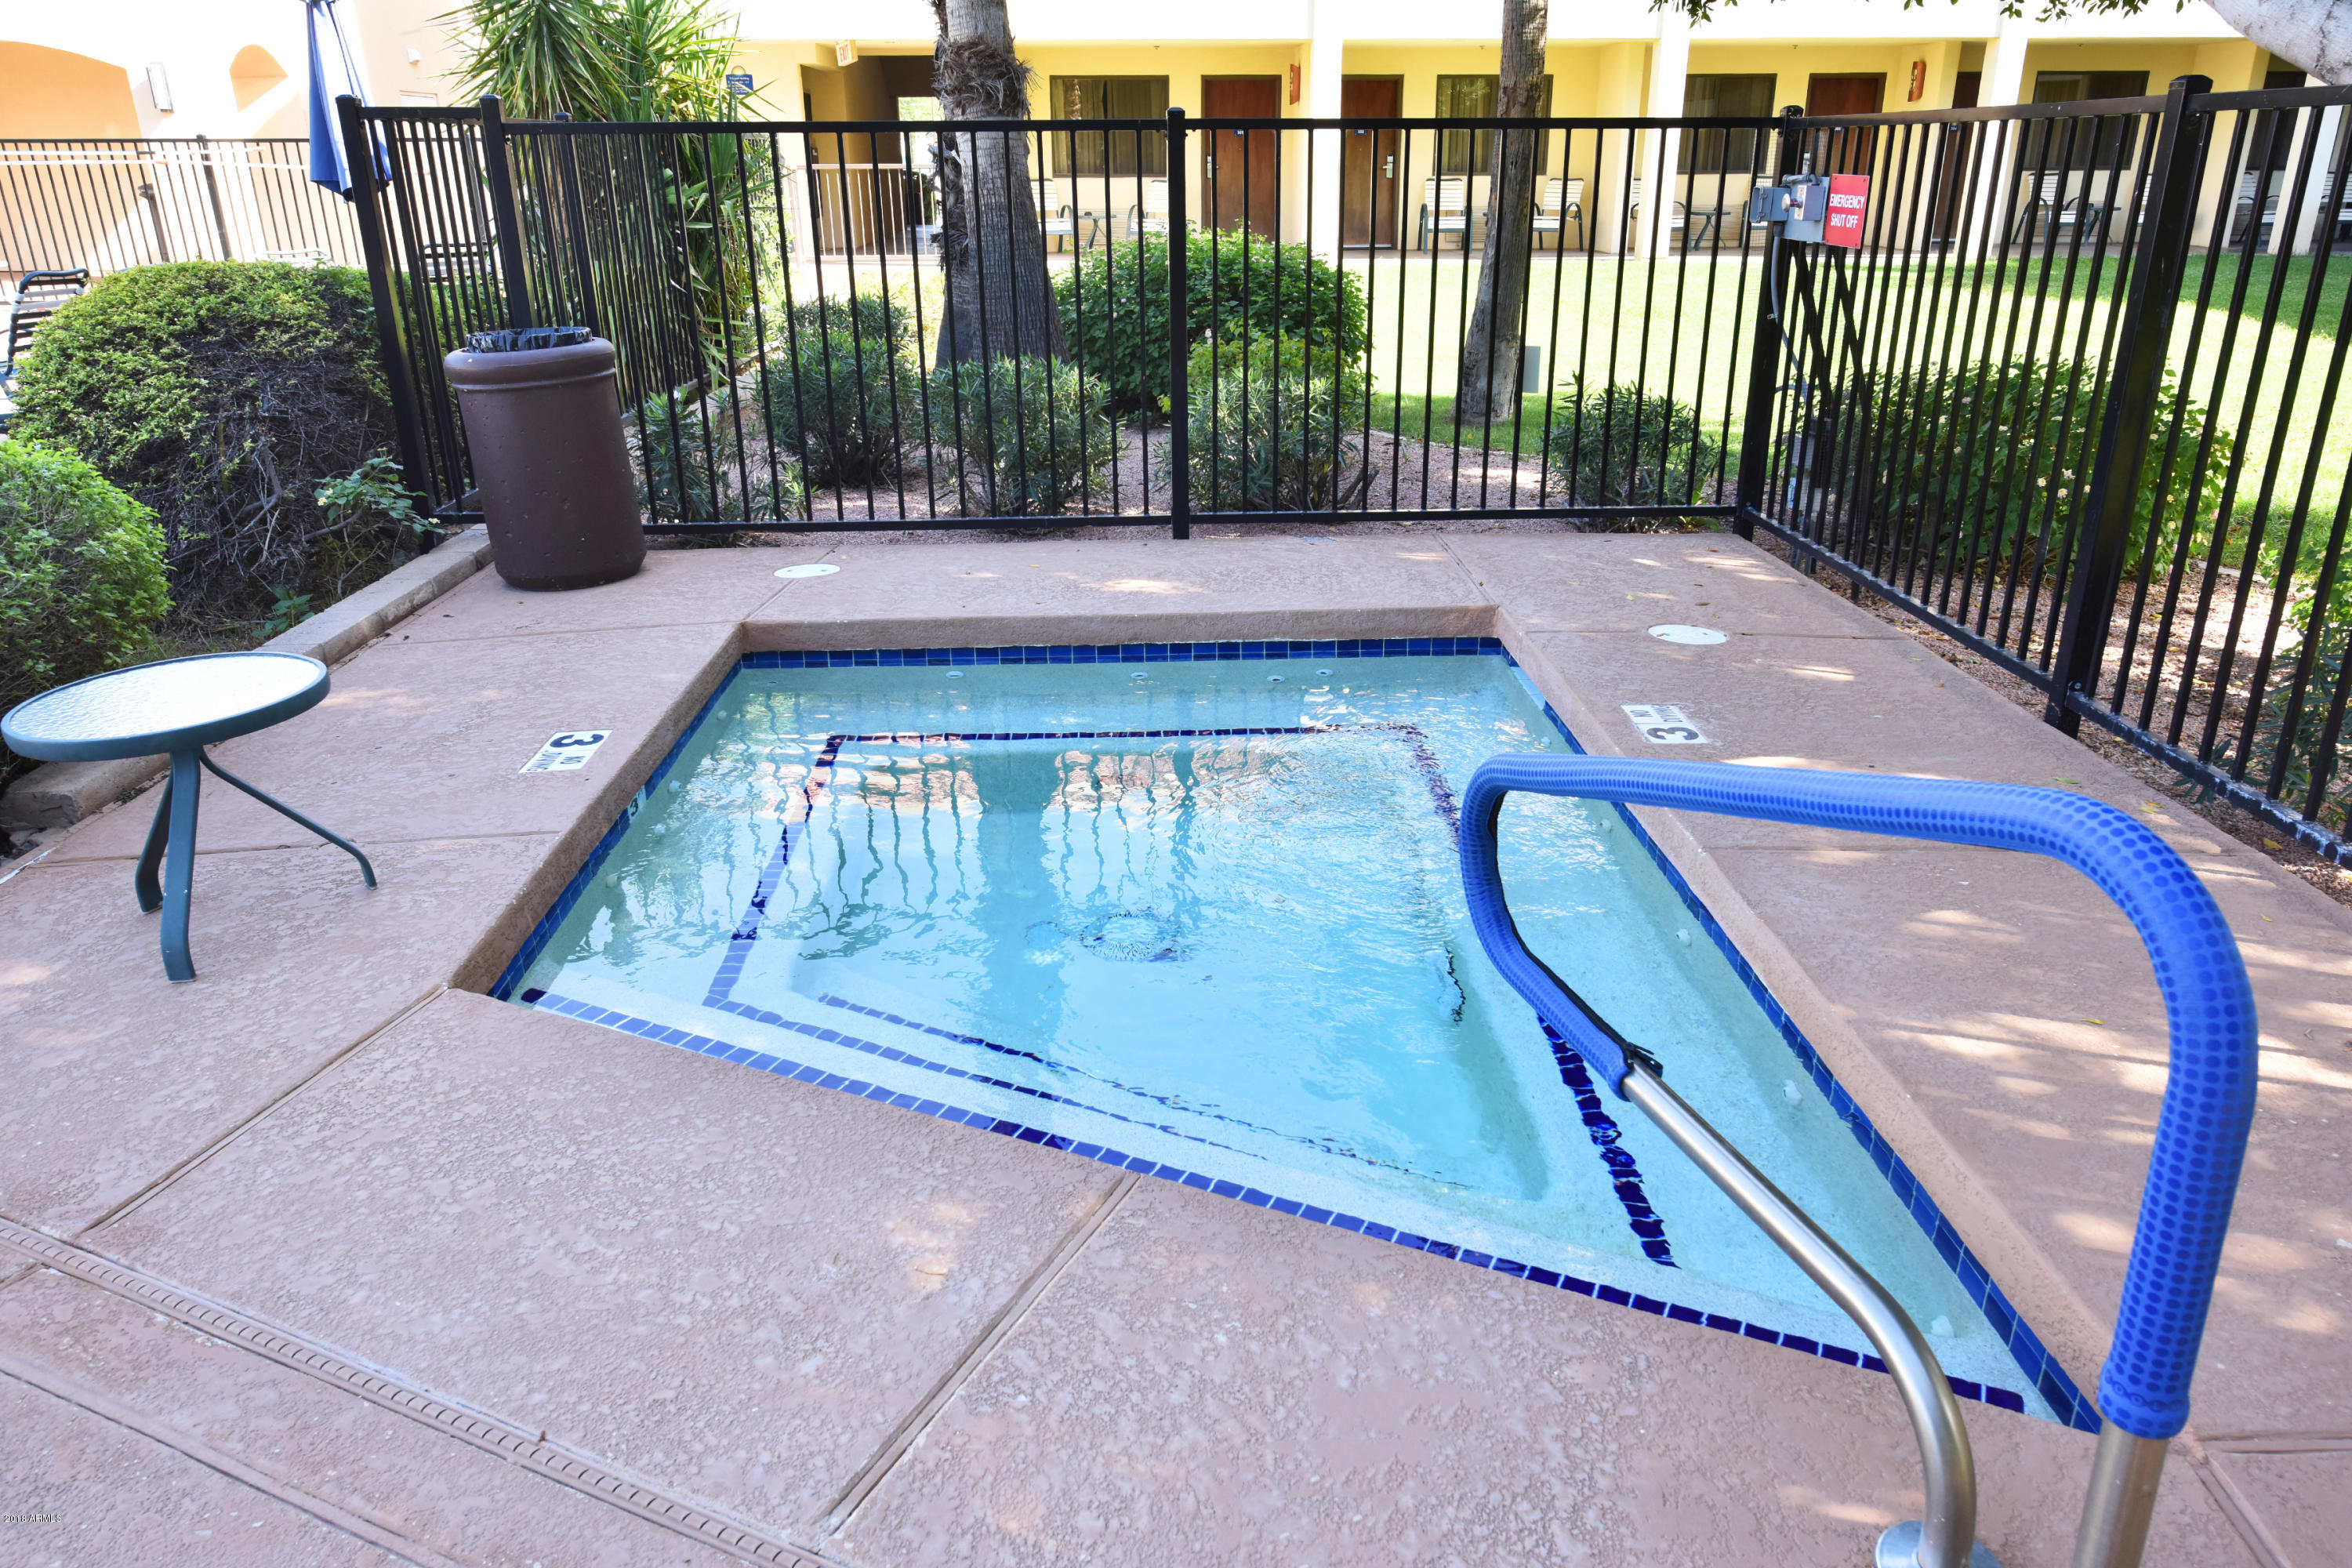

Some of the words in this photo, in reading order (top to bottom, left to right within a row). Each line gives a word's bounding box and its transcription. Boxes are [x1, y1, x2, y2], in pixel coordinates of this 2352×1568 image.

[839, 44, 849, 63] EXIT
[1829, 194, 1865, 209] EMERGENCY
[1830, 213, 1846, 227] SHUT
[1846, 215, 1858, 228] OFF
[550, 733, 604, 748] 3
[1646, 726, 1700, 741] 3
[526, 752, 563, 771] DIVING
[560, 756, 586, 764] NO
